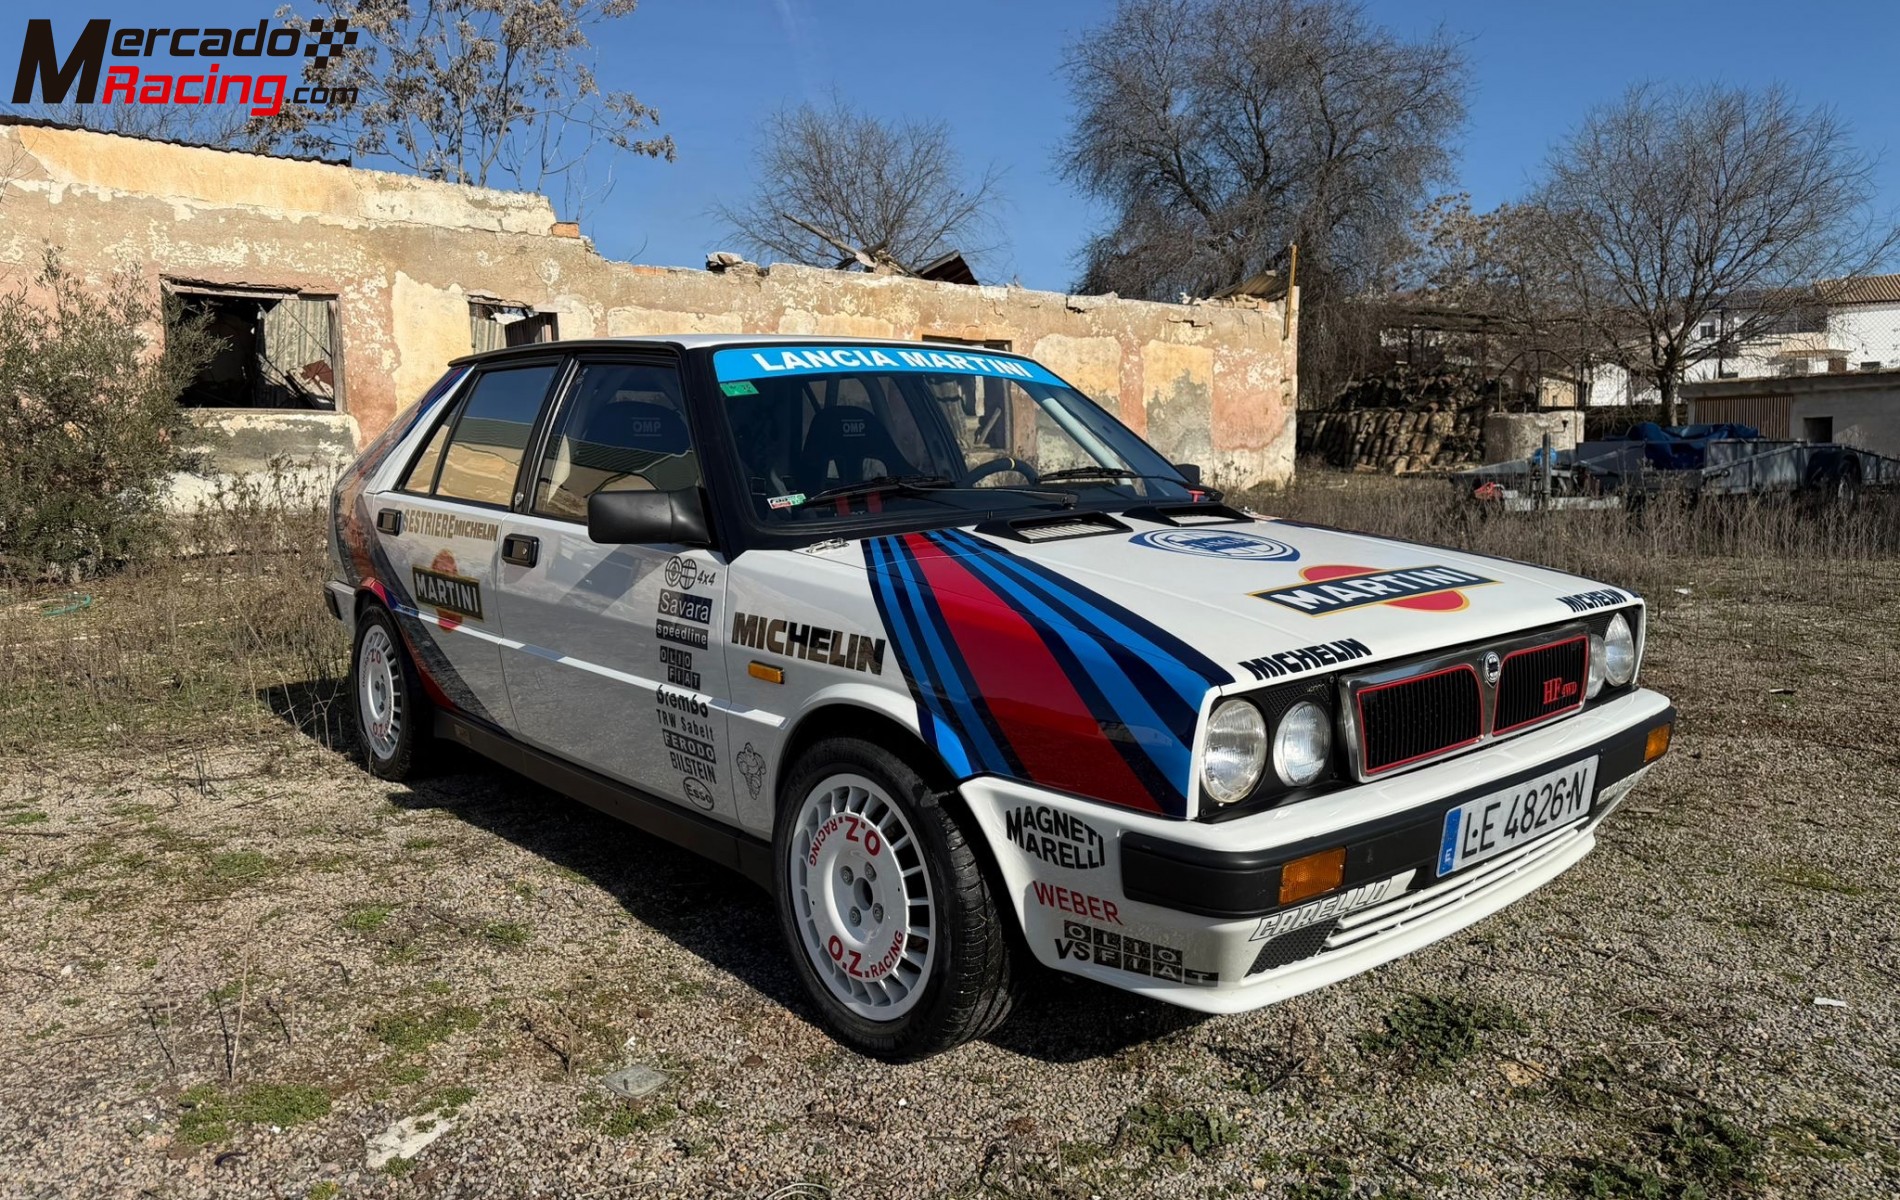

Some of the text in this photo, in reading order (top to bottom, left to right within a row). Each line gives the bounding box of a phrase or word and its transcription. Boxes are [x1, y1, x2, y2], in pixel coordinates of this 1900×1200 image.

[752, 350, 1033, 378] LANCIA MARTINI
[633, 421, 661, 433] OMP
[842, 422, 866, 434] OMP
[404, 509, 498, 541] SESTRIERE MICHELIN
[415, 573, 479, 613] MARTINI
[697, 569, 716, 586] 4x4
[1271, 567, 1480, 610] MARTINI
[660, 592, 710, 622] Savara
[1555, 588, 1628, 613] MICHELIN
[657, 623, 708, 645] speedline
[731, 611, 886, 676] MICHELIN
[660, 647, 692, 669] OLIO
[1238, 637, 1373, 681] MICHELIN
[668, 666, 700, 688] FIAT
[1543, 677, 1562, 704] HF
[656, 684, 709, 718] brembo
[656, 708, 715, 742] TRW Sabelt
[663, 731, 715, 761] FERODO
[670, 750, 717, 785] BILSTEIN
[809, 818, 838, 867] RACING
[1006, 806, 1104, 850] MAGNETI
[1006, 831, 1105, 869] MARELLI
[1444, 848, 1453, 863] E
[1032, 880, 1123, 925] WEBER
[870, 929, 905, 979] RACING
[1066, 922, 1181, 965] OLIO
[1054, 938, 1214, 986] VS FIAT
